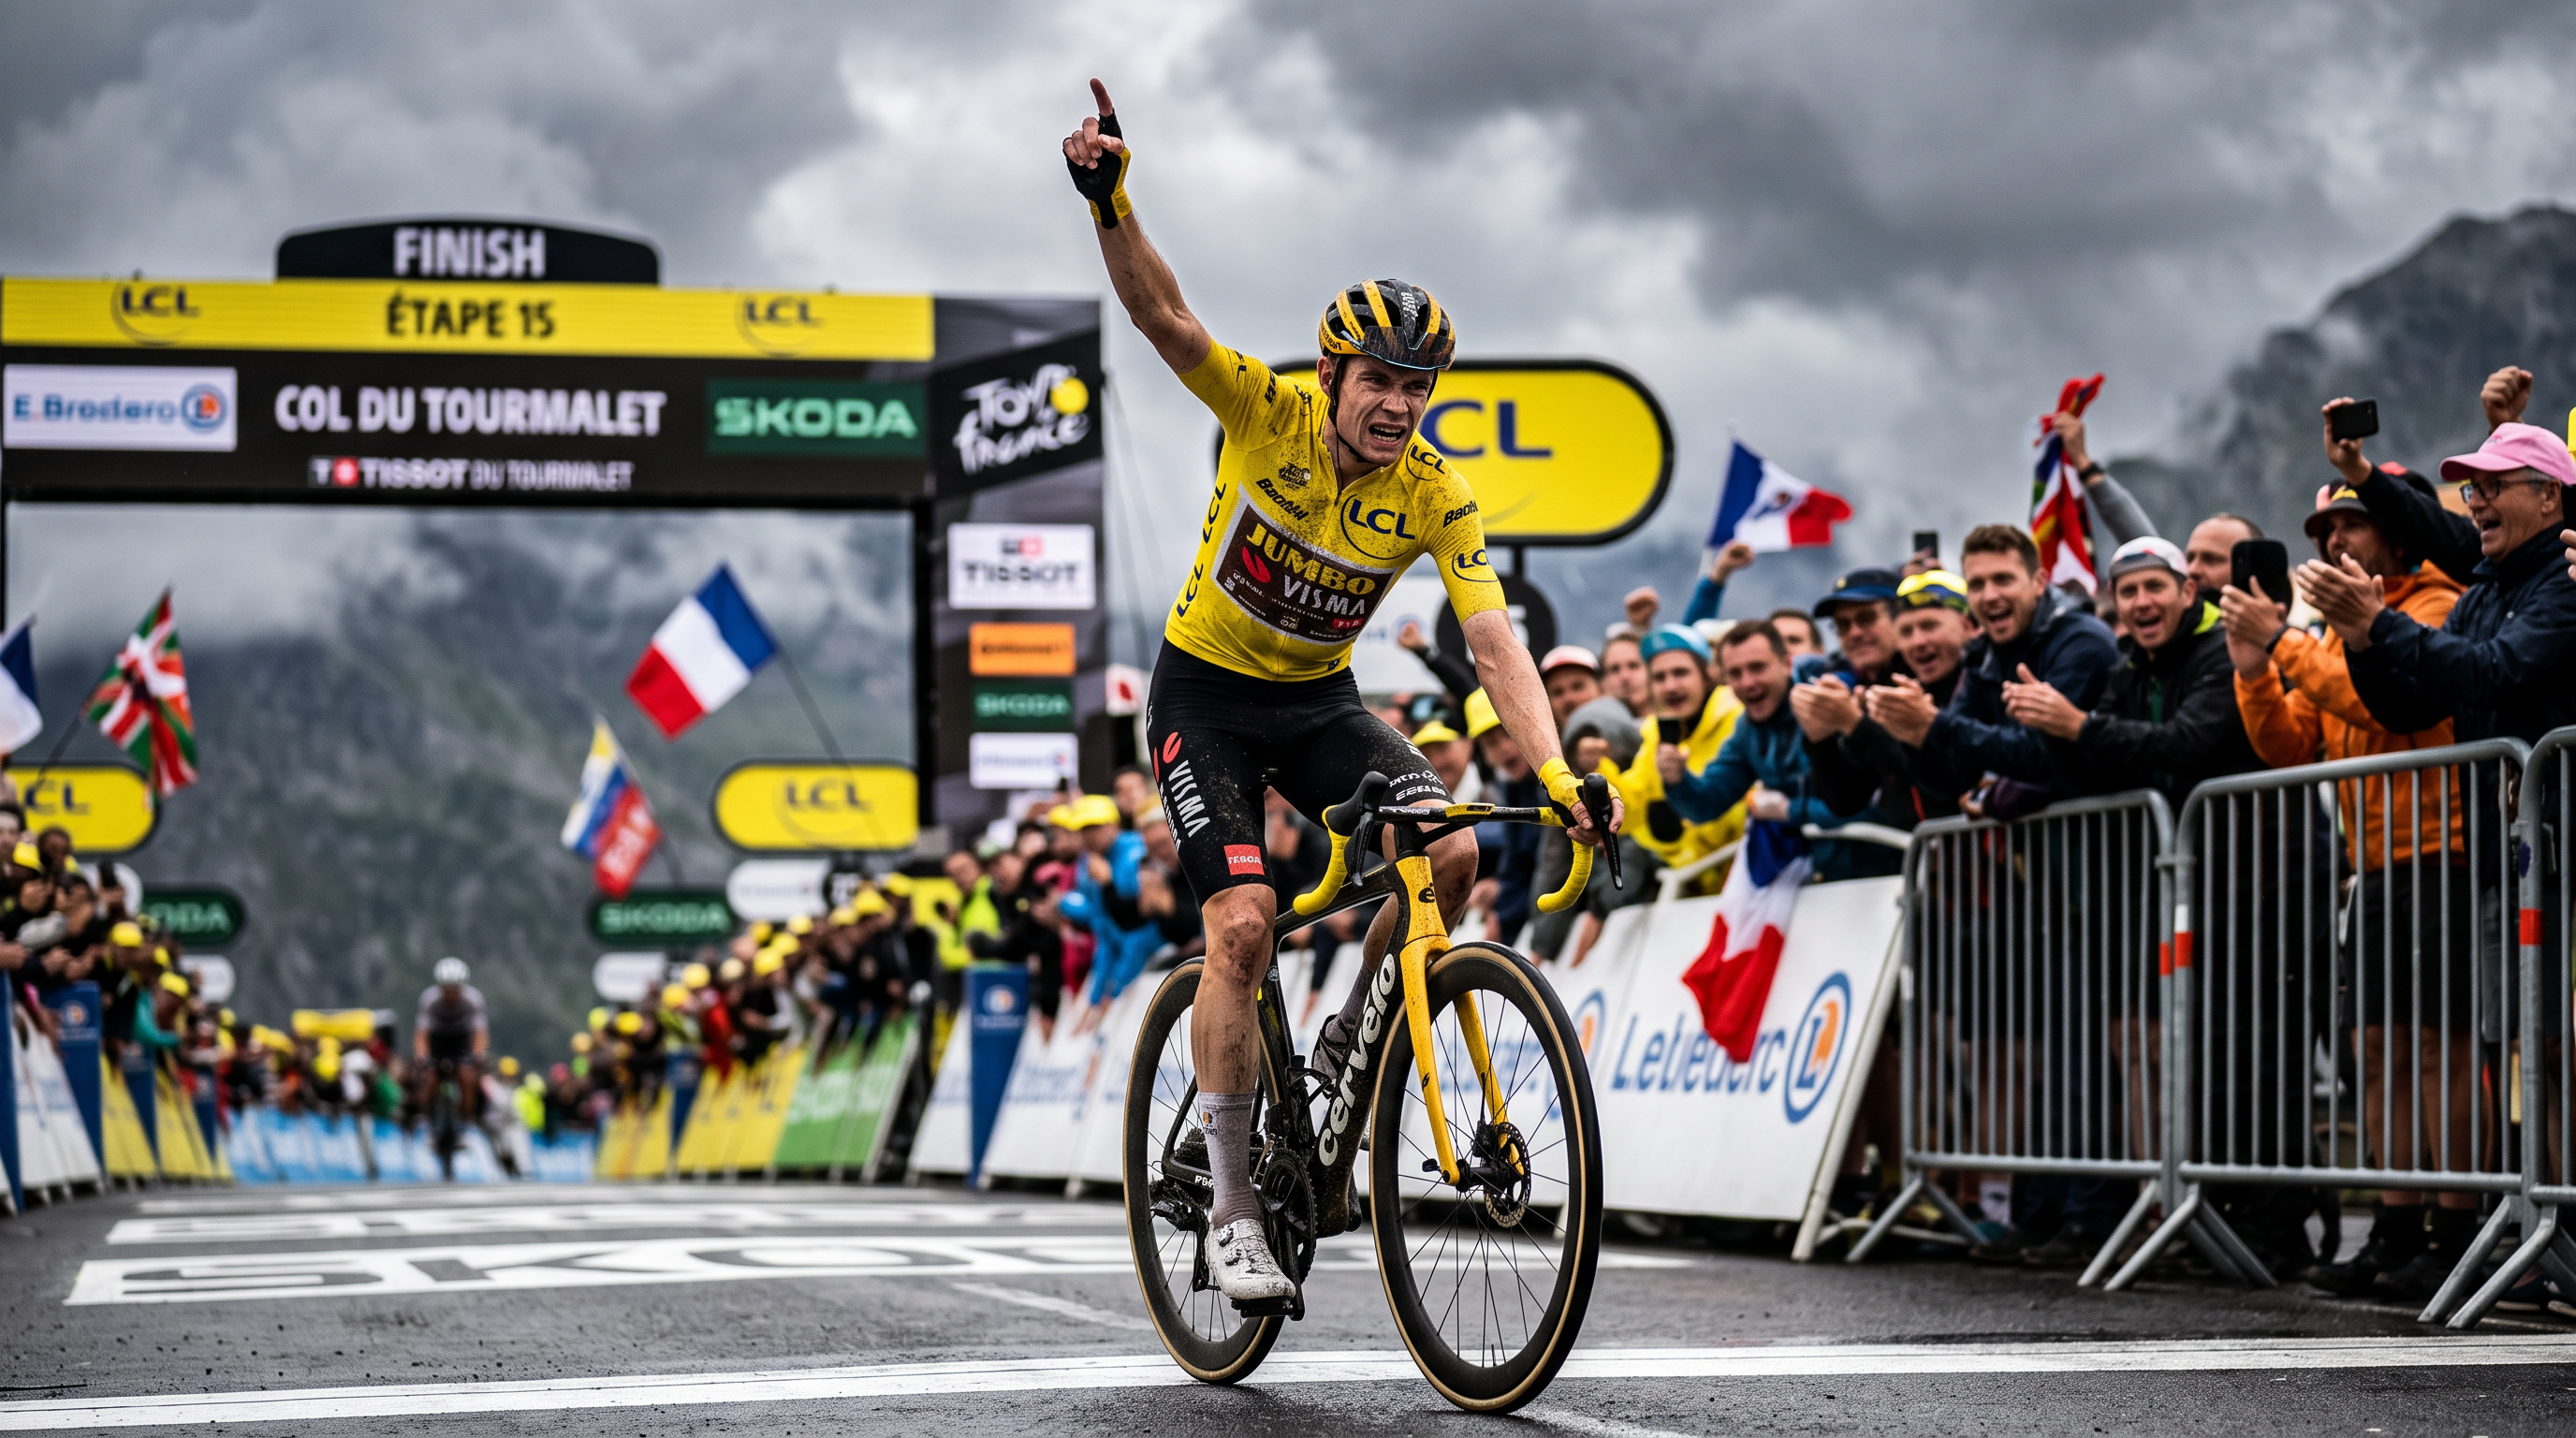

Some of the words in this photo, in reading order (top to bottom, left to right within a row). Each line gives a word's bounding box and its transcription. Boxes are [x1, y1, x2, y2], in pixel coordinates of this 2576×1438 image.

[393, 227, 546, 277] FINISH
[121, 285, 200, 317] LCL
[387, 287, 505, 338] ÉTAPE
[520, 301, 556, 338] 15
[744, 296, 825, 328] LCL
[275, 385, 352, 433] COL
[358, 386, 416, 433] DU
[421, 387, 666, 437] TOURMALET
[714, 397, 918, 439] SKODA
[1419, 398, 1553, 459] CL
[359, 457, 468, 490] TISSOT
[1410, 445, 1445, 475] LCL
[1203, 483, 1227, 544] LCL
[1349, 499, 1416, 540] LCL
[1246, 522, 1376, 595] JUMBO
[1457, 549, 1491, 569] LC
[1177, 563, 1204, 618] LCL
[1283, 574, 1366, 616] VISMA
[24, 779, 91, 815] CL
[784, 779, 871, 813] LCL
[1168, 759, 1210, 838] VISMA
